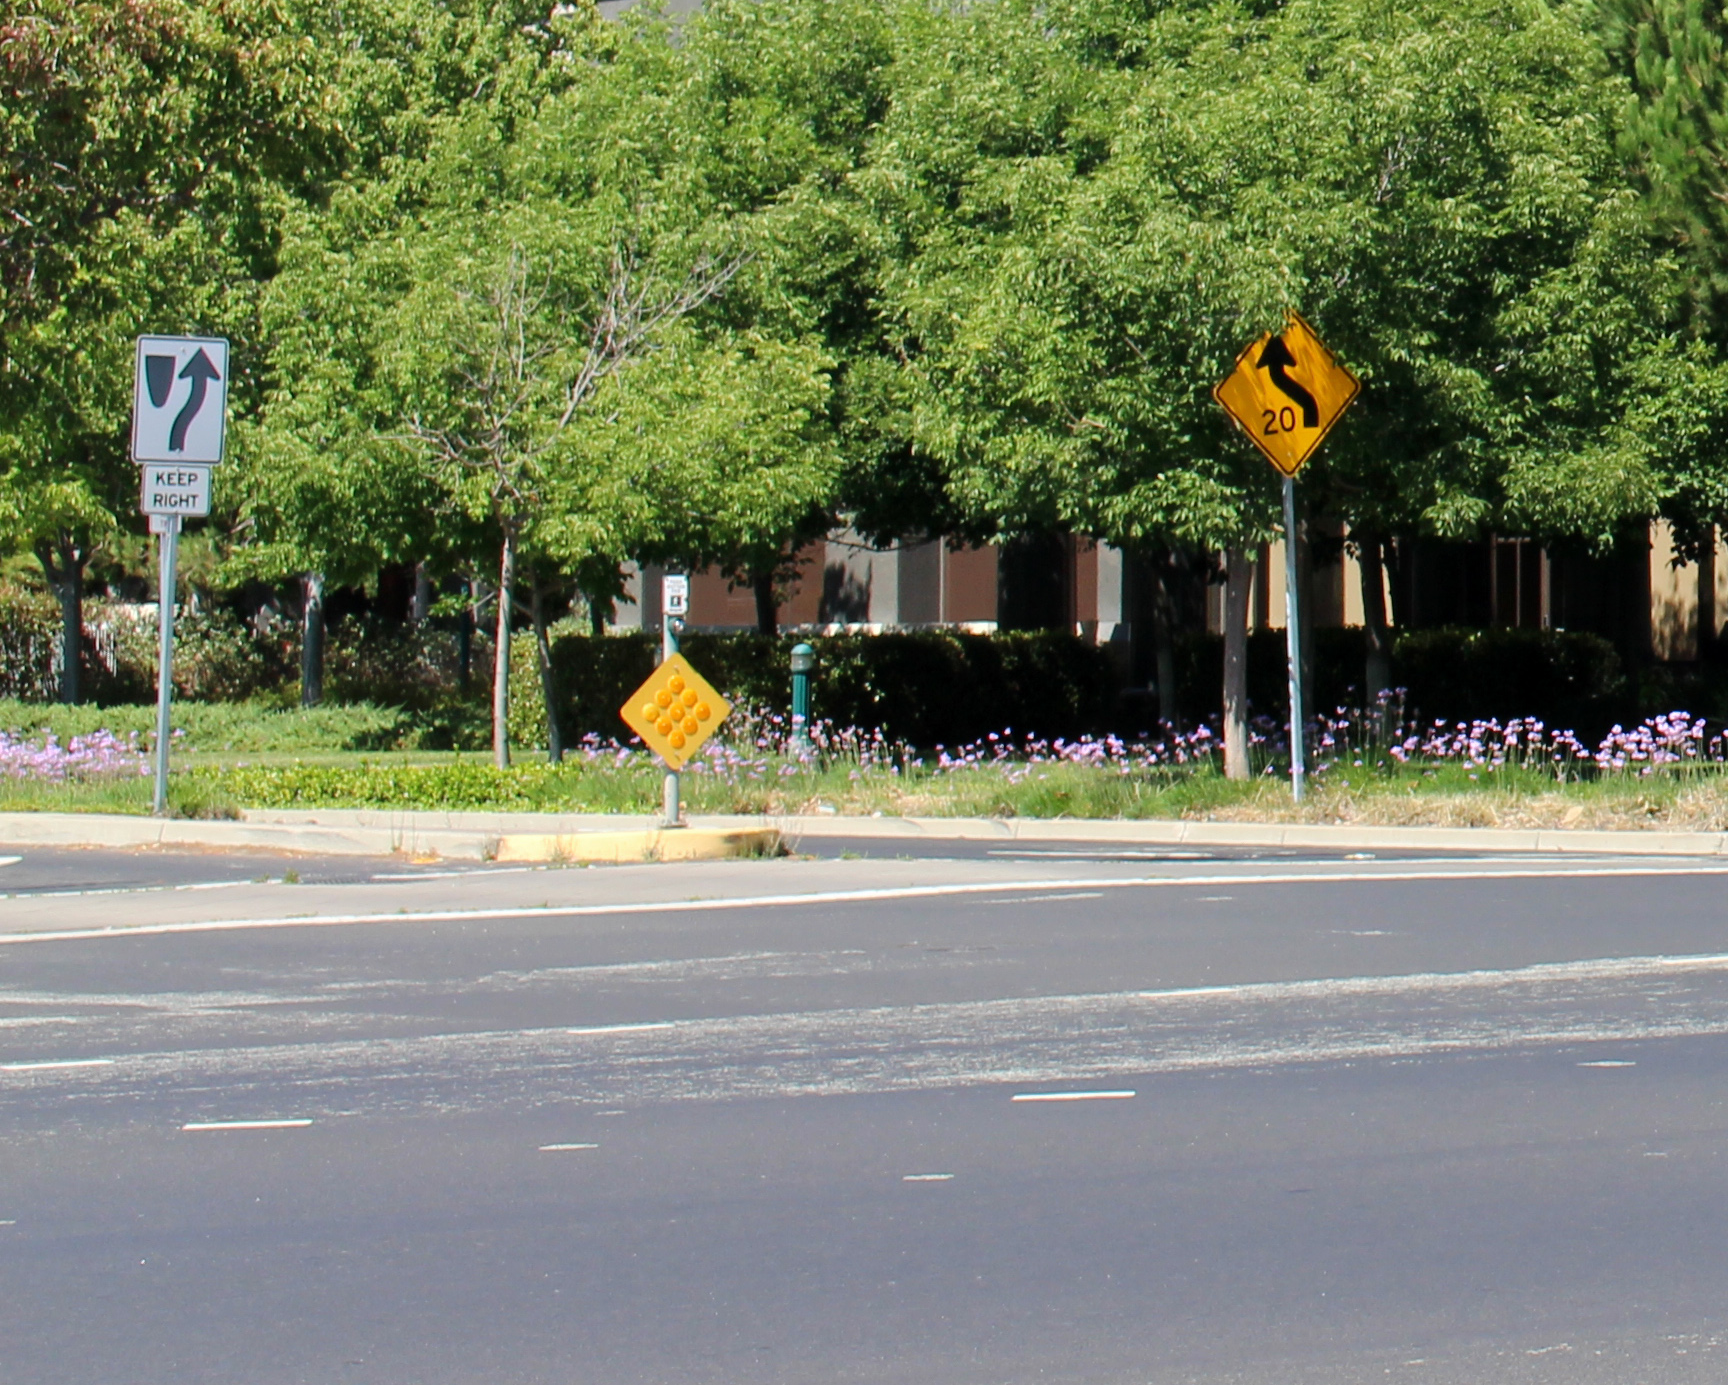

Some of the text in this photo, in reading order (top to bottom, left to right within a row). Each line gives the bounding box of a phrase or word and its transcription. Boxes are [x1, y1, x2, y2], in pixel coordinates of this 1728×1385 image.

[1262, 406, 1296, 435] 20
[156, 472, 198, 486] KEEP
[153, 494, 199, 507] RIGHT
